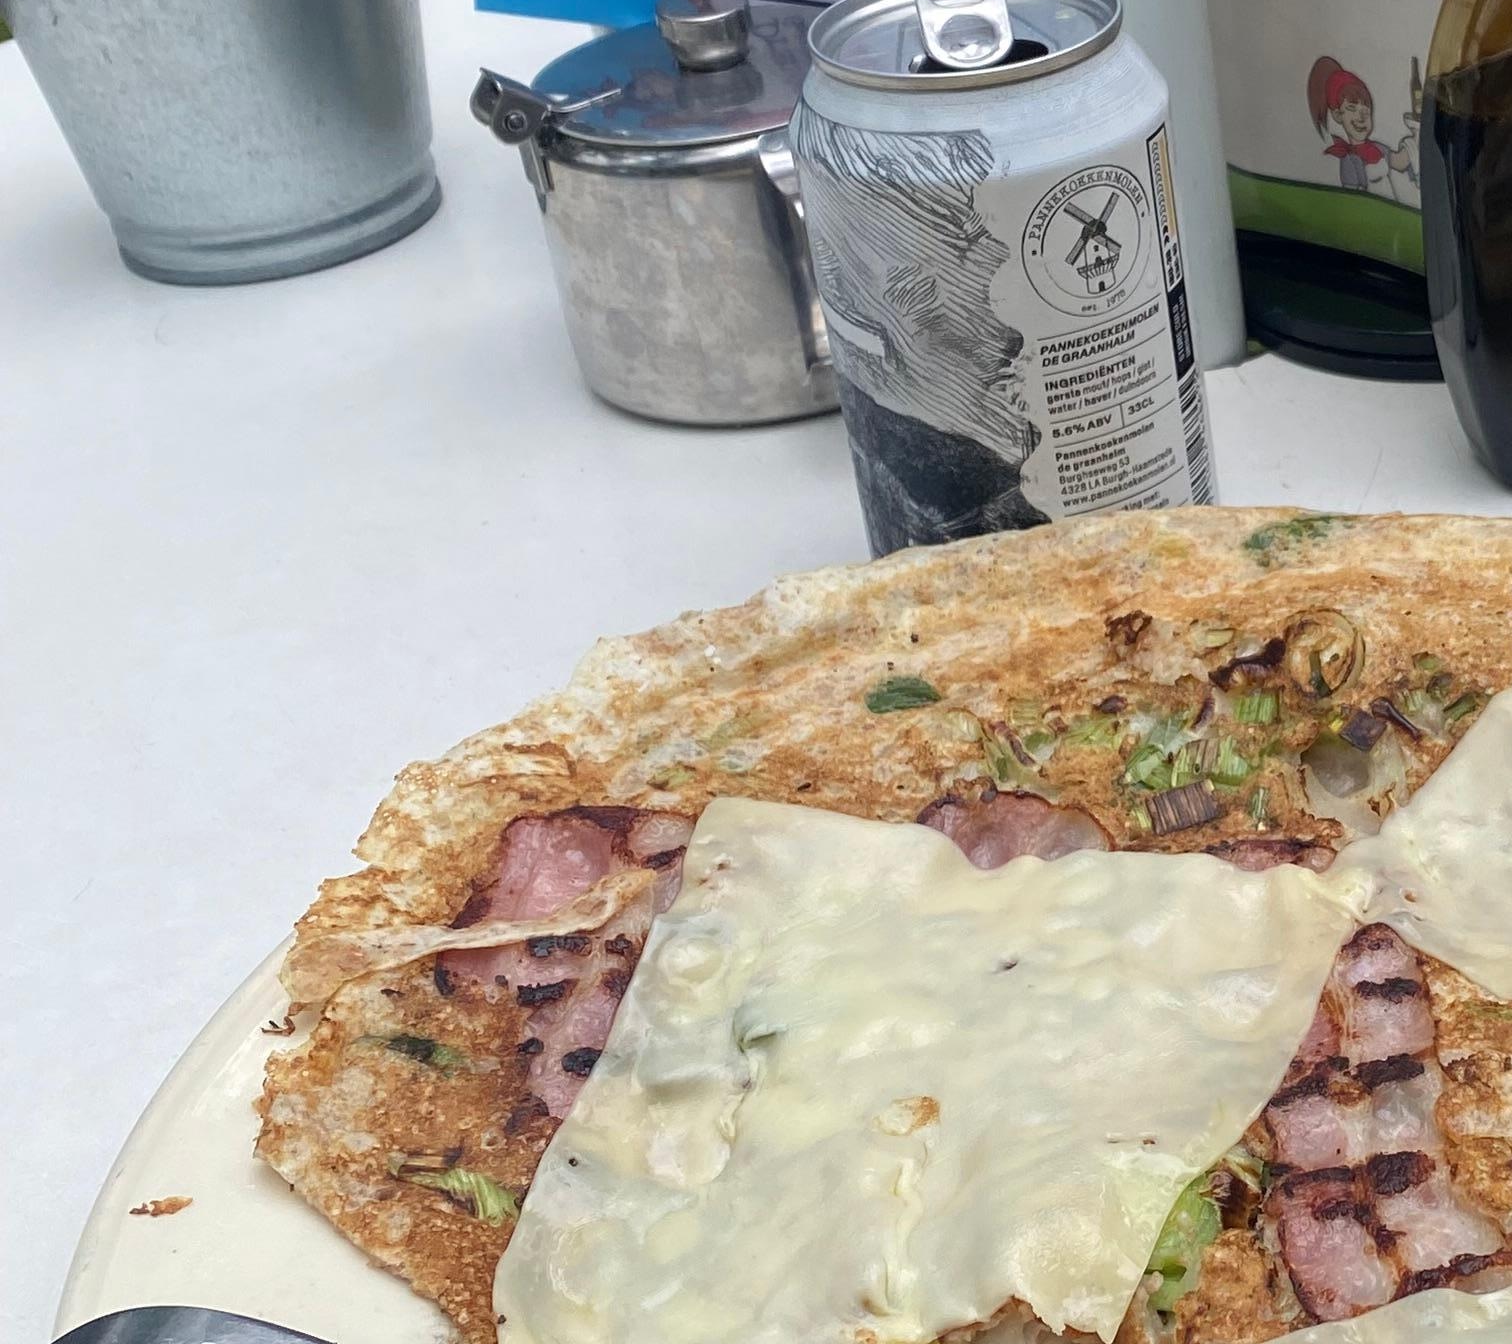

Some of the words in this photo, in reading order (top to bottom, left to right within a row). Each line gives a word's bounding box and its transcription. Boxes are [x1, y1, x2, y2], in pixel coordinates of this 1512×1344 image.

[1040, 301, 1160, 356] PANNEKOEKENMOLEN
[1042, 356, 1059, 368] DE
[1061, 330, 1135, 364] GRAANHALM
[1045, 355, 1136, 392] INGREDIËNTEN
[1047, 387, 1081, 405] gerste
[1137, 360, 1151, 376] gist
[1048, 401, 1078, 415] water
[1084, 390, 1112, 407] haver
[1127, 397, 1155, 415] 33CL
[1052, 424, 1085, 439] 5.6%
[1087, 414, 1112, 431] ABV
[1055, 422, 1154, 462] Pannenkoekenmolen
[1057, 463, 1071, 474] de
[1073, 447, 1126, 472] graanhalm
[1059, 460, 1118, 485] Burghseweg
[1119, 456, 1130, 468] 53
[1061, 482, 1086, 495] 4328
[1088, 478, 1101, 489] LA
